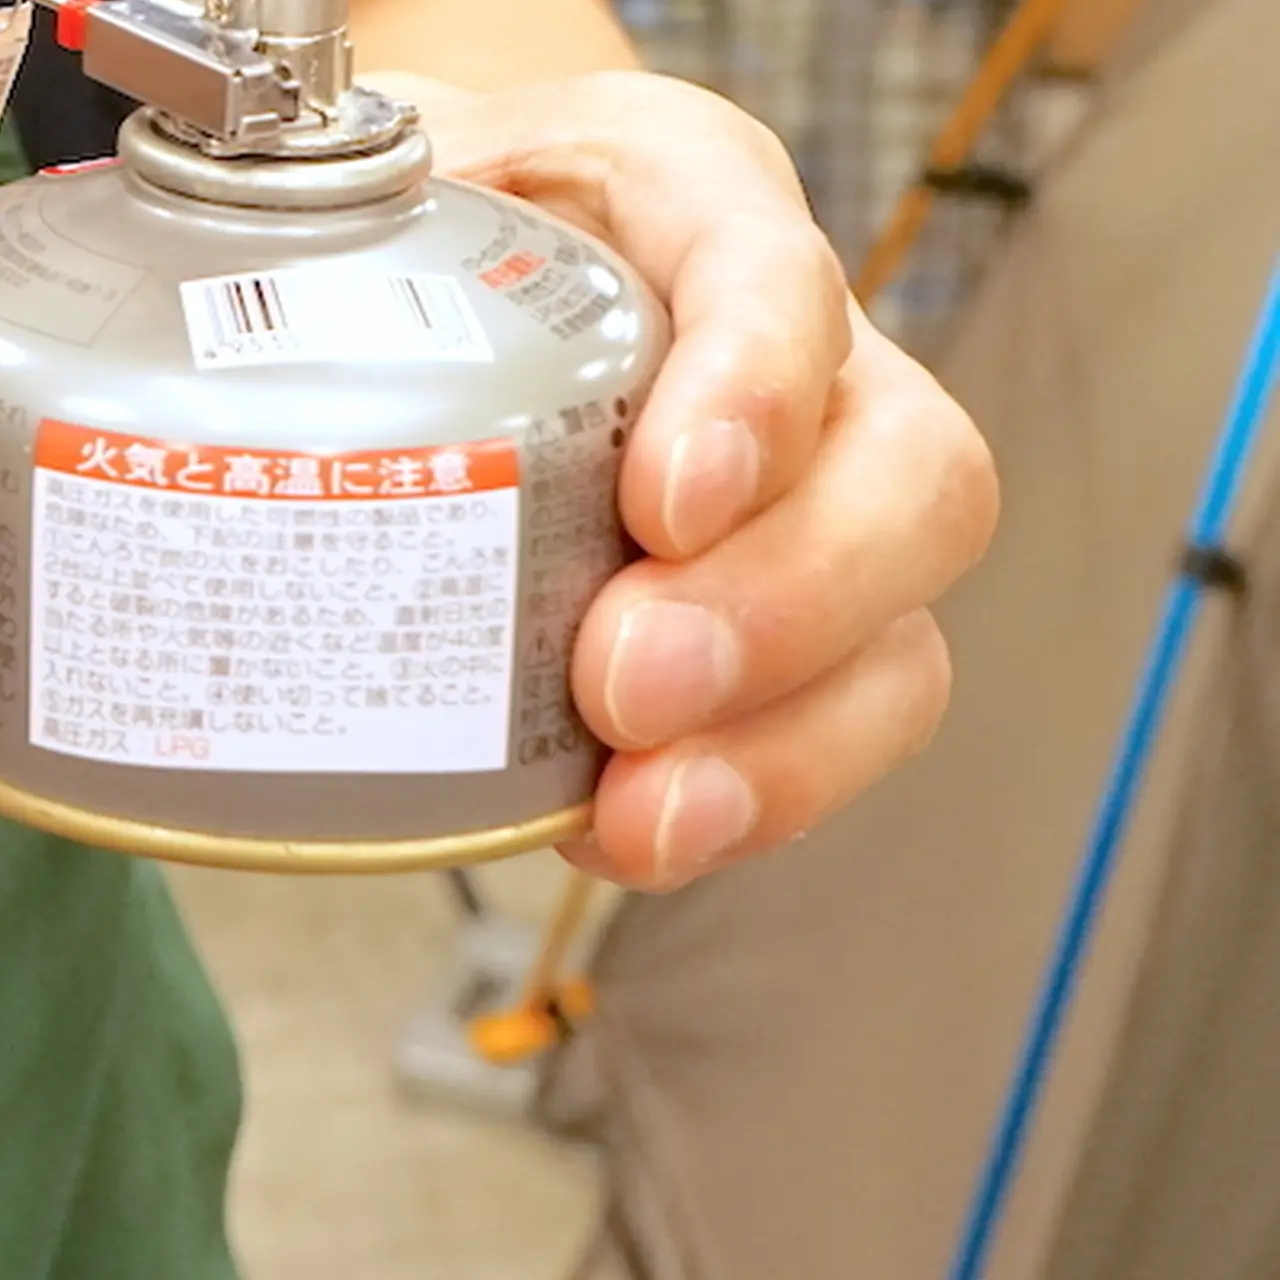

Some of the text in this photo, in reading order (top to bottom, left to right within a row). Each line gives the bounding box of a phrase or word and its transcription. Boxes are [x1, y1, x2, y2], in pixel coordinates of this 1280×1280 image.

[76, 437, 472, 496] 火気と高温に注意
